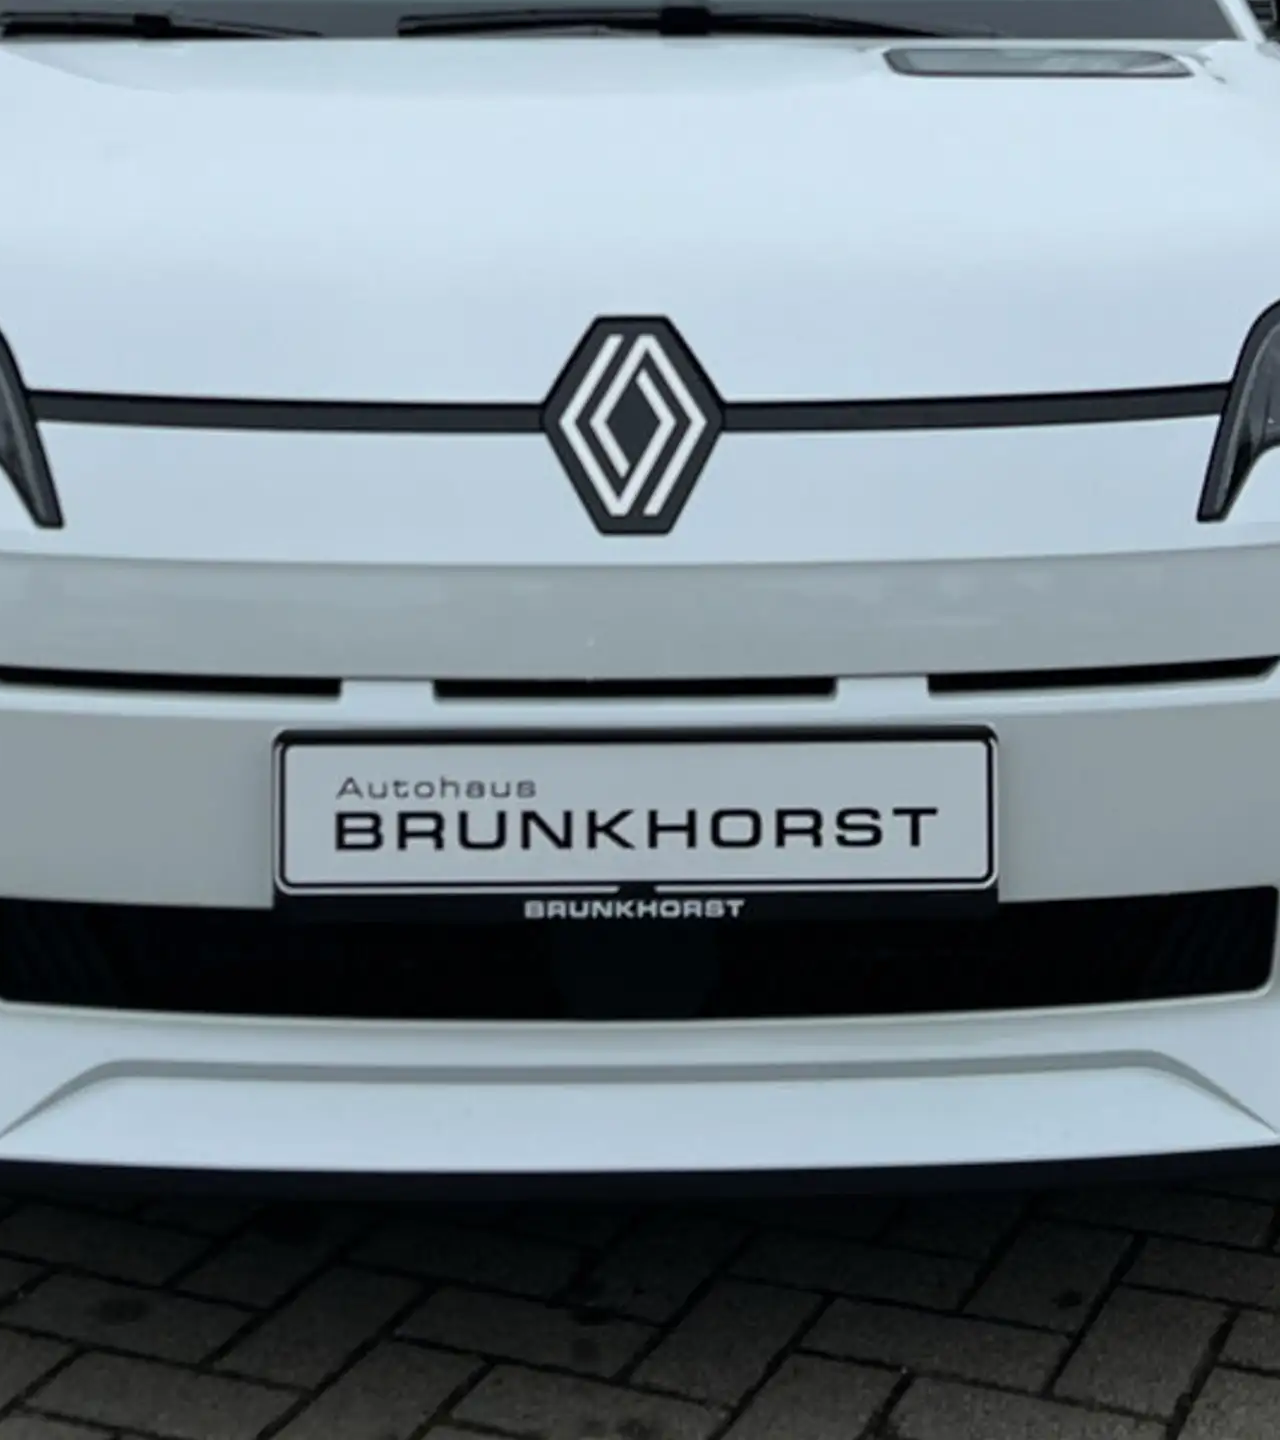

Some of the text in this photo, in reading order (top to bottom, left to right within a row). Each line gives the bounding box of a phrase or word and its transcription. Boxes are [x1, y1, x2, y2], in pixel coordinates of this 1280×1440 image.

[335, 776, 537, 800] Autohaus
[335, 807, 938, 851] BRUNKHORST
[524, 899, 745, 920] BRUNKHORST
